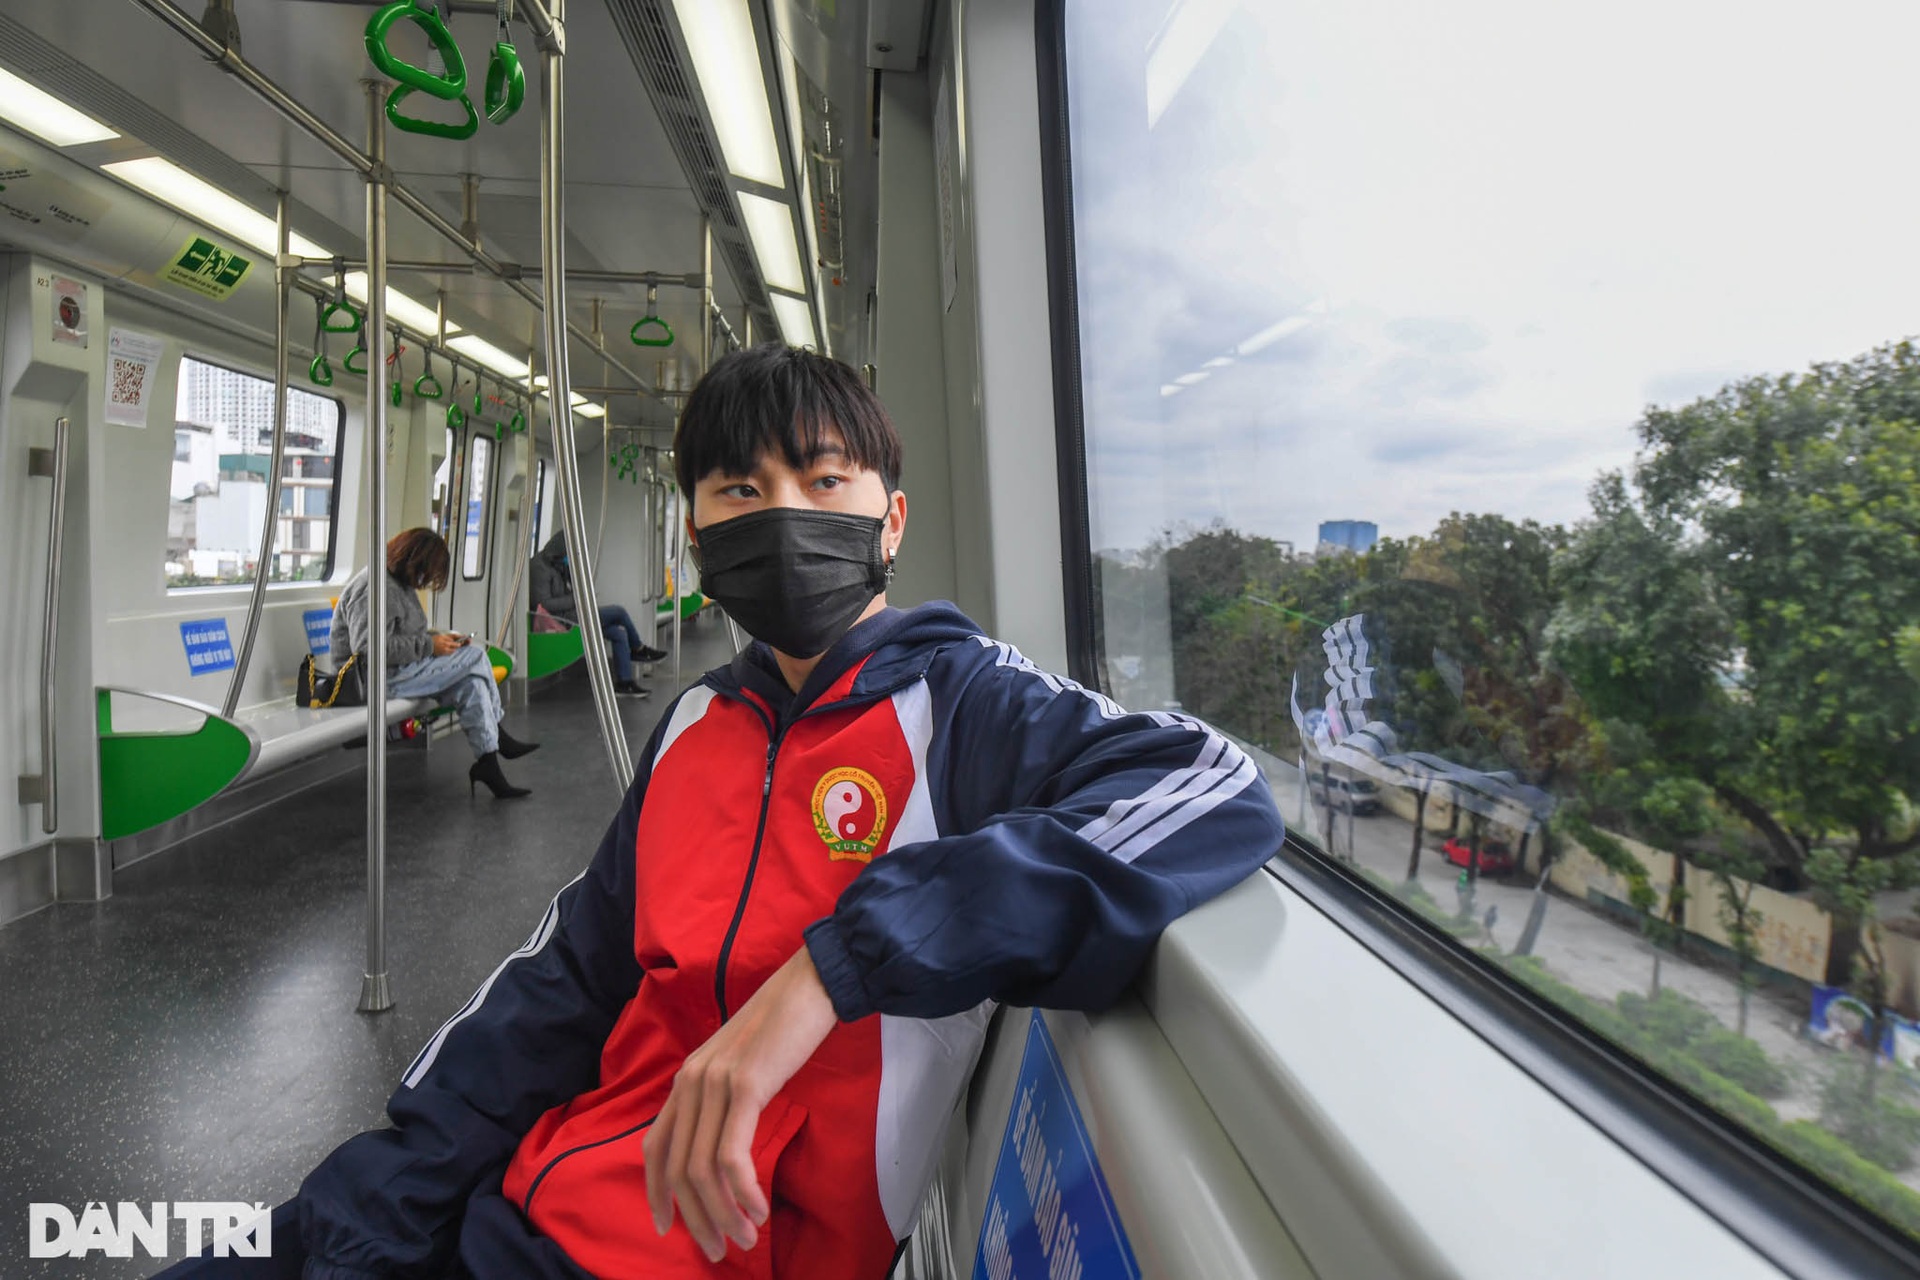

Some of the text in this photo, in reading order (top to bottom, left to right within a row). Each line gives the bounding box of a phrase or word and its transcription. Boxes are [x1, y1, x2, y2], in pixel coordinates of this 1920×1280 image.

[1020, 1099, 1046, 1208] ĐẢM
[1034, 1147, 1063, 1258] BẢO
[1049, 1211, 1082, 1280] GIÃ
